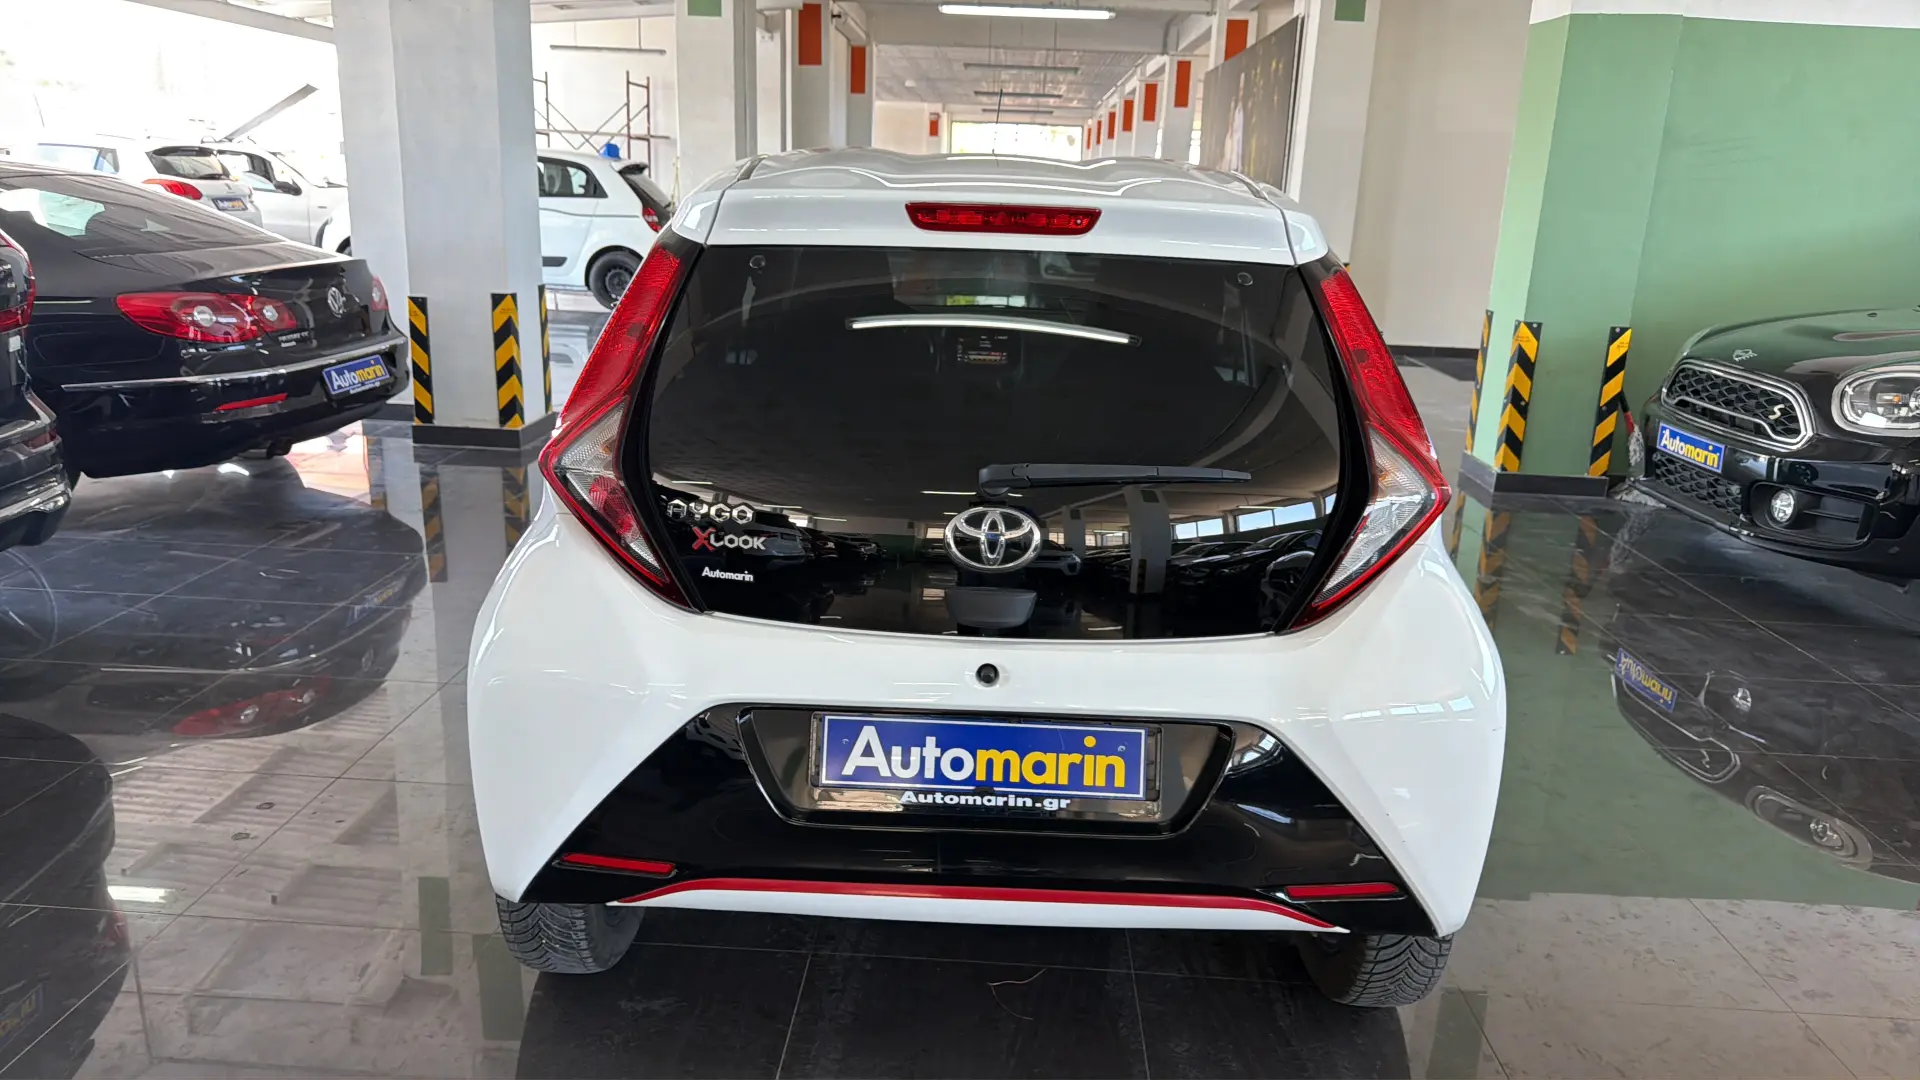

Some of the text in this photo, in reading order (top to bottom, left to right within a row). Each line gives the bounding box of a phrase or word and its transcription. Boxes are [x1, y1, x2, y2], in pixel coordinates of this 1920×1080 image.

[331, 360, 385, 390] Automarin
[1660, 428, 1719, 468] Automarin
[667, 499, 754, 525] AYGO
[702, 567, 754, 582] Automarin
[841, 725, 1126, 788] Automarin
[900, 791, 1071, 810] Automarin.gr
